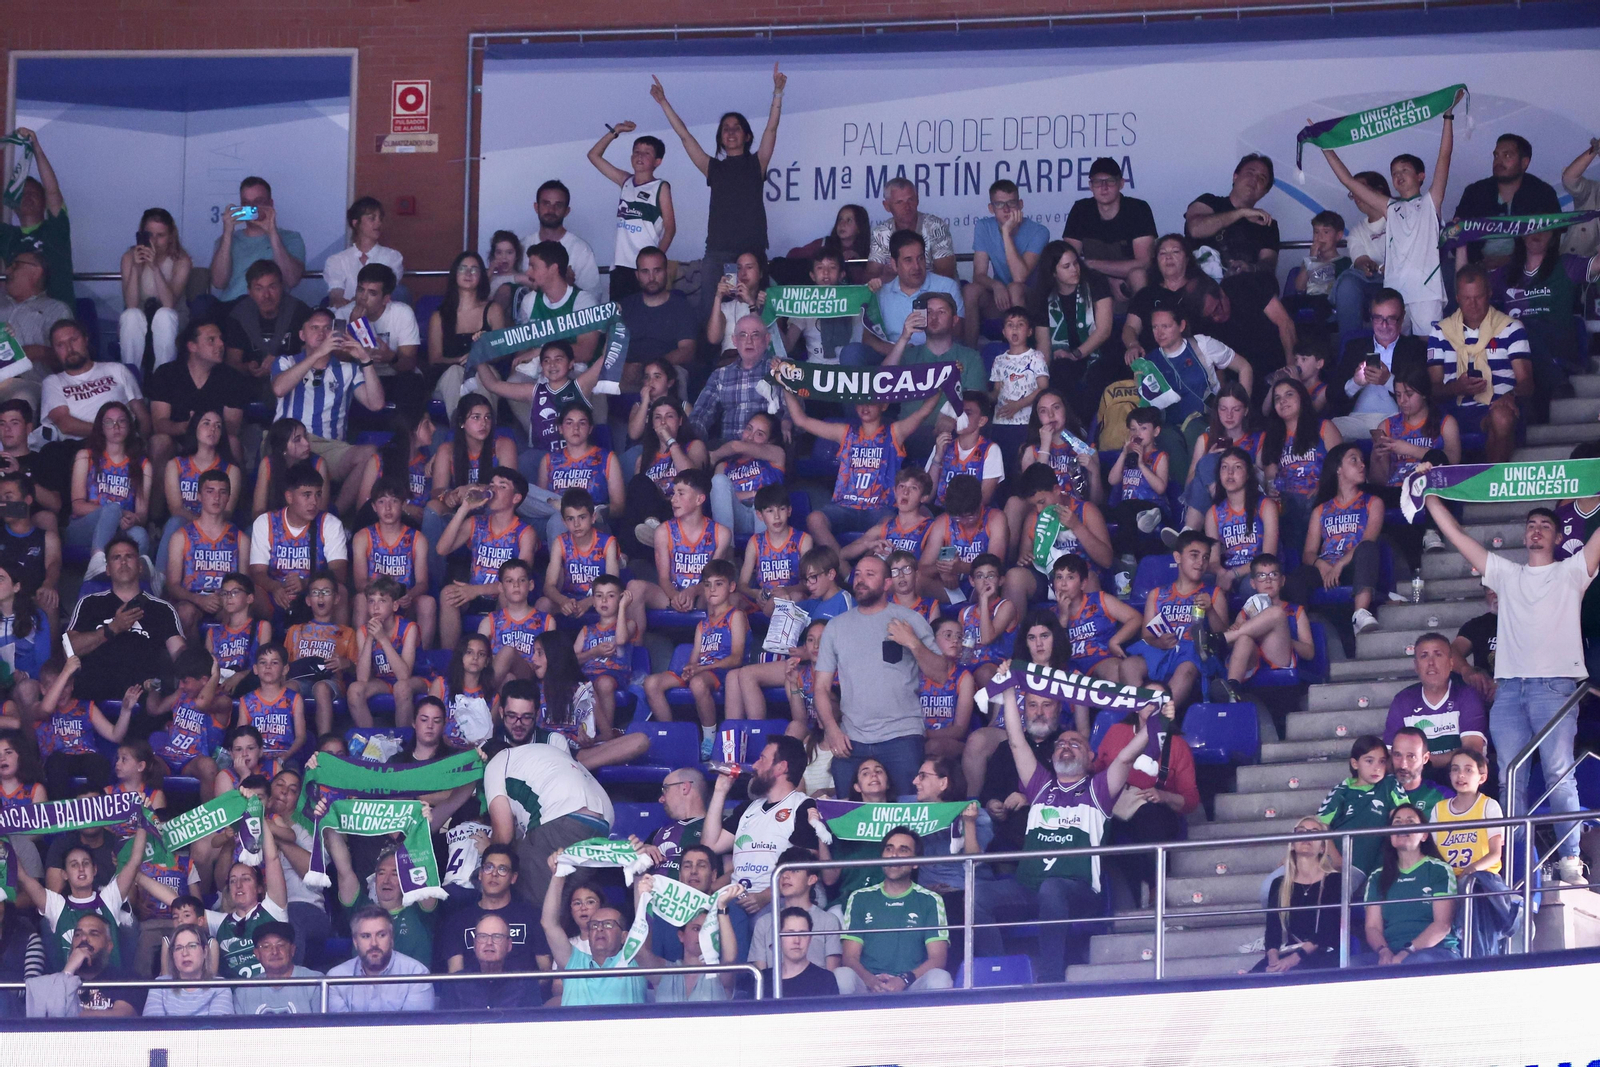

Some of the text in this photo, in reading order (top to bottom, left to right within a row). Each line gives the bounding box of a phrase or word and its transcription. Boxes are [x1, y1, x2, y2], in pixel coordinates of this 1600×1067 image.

[1359, 100, 1416, 126] UNICAJA
[1350, 104, 1431, 142] BALONCESTO
[843, 111, 1137, 156] PALACIO DE DEPORTES
[765, 160, 801, 202] SÉ
[815, 165, 852, 200] Mª
[995, 155, 1135, 194] CARPEA
[617, 220, 642, 233] álaga
[1464, 220, 1521, 235] UNICAJA
[782, 287, 837, 300] UNICAJA
[1523, 286, 1551, 297] Unicaja
[504, 302, 622, 347] UNICAJA BALONCES
[812, 364, 953, 394] UNICAJA
[62, 376, 117, 398] STRANGER
[71, 386, 112, 401] THINGS
[1107, 385, 1139, 399] VANS
[860, 447, 883, 458] FUENTE
[851, 458, 880, 469] PALMERA
[410, 474, 426, 484] ENTE
[553, 469, 592, 480] CB FUENTE
[1504, 465, 1566, 481] UNICAJA
[181, 481, 190, 492] CB
[553, 479, 588, 490] PALMERA
[740, 481, 753, 491] 17
[856, 473, 871, 489] 10
[1489, 478, 1579, 497] BALONCESTO
[1324, 513, 1360, 526] CB FUENTE
[1223, 522, 1257, 538] CB FUEE
[1326, 523, 1357, 537] PALMERA
[1055, 540, 1077, 548] UENTE
[1225, 533, 1256, 548] PALMERA
[1337, 538, 1345, 551] 8
[194, 550, 232, 562] CB FUENTE
[277, 545, 310, 558] CB FUEN
[488, 547, 513, 559] FUENTE
[675, 552, 708, 564] CB FUENTE
[277, 558, 310, 570] PALMER
[383, 554, 407, 565] FUENTE
[761, 559, 792, 571] CB FUEN
[195, 561, 231, 572] PALMERA
[375, 564, 405, 576] PALMERA
[570, 563, 579, 574] CB
[203, 576, 222, 588] 23
[763, 569, 790, 582] PALMER
[1162, 605, 1192, 615] CB FUEN
[1069, 621, 1097, 639] FUENTE
[502, 633, 512, 644] CB
[299, 639, 336, 652] CB FUENTE
[375, 655, 384, 666] CB
[930, 695, 954, 707] FUENTE
[177, 706, 187, 717] CB
[255, 714, 288, 727] CB FUENTE
[1433, 722, 1456, 733] Unicaja
[172, 733, 194, 749] 68
[352, 801, 414, 817] UNICAJA
[872, 806, 929, 822] UNICAJA
[0, 804, 51, 829] NICAJA
[341, 814, 418, 831] BALONCEST
[167, 808, 228, 849] ONCESTO
[856, 819, 939, 838] BALOESTO
[1441, 829, 1478, 847] LAKERS
[751, 842, 777, 851] Unicaja
[447, 848, 464, 875] 4
[1447, 848, 1473, 868] 23
[735, 861, 769, 874] málaga
